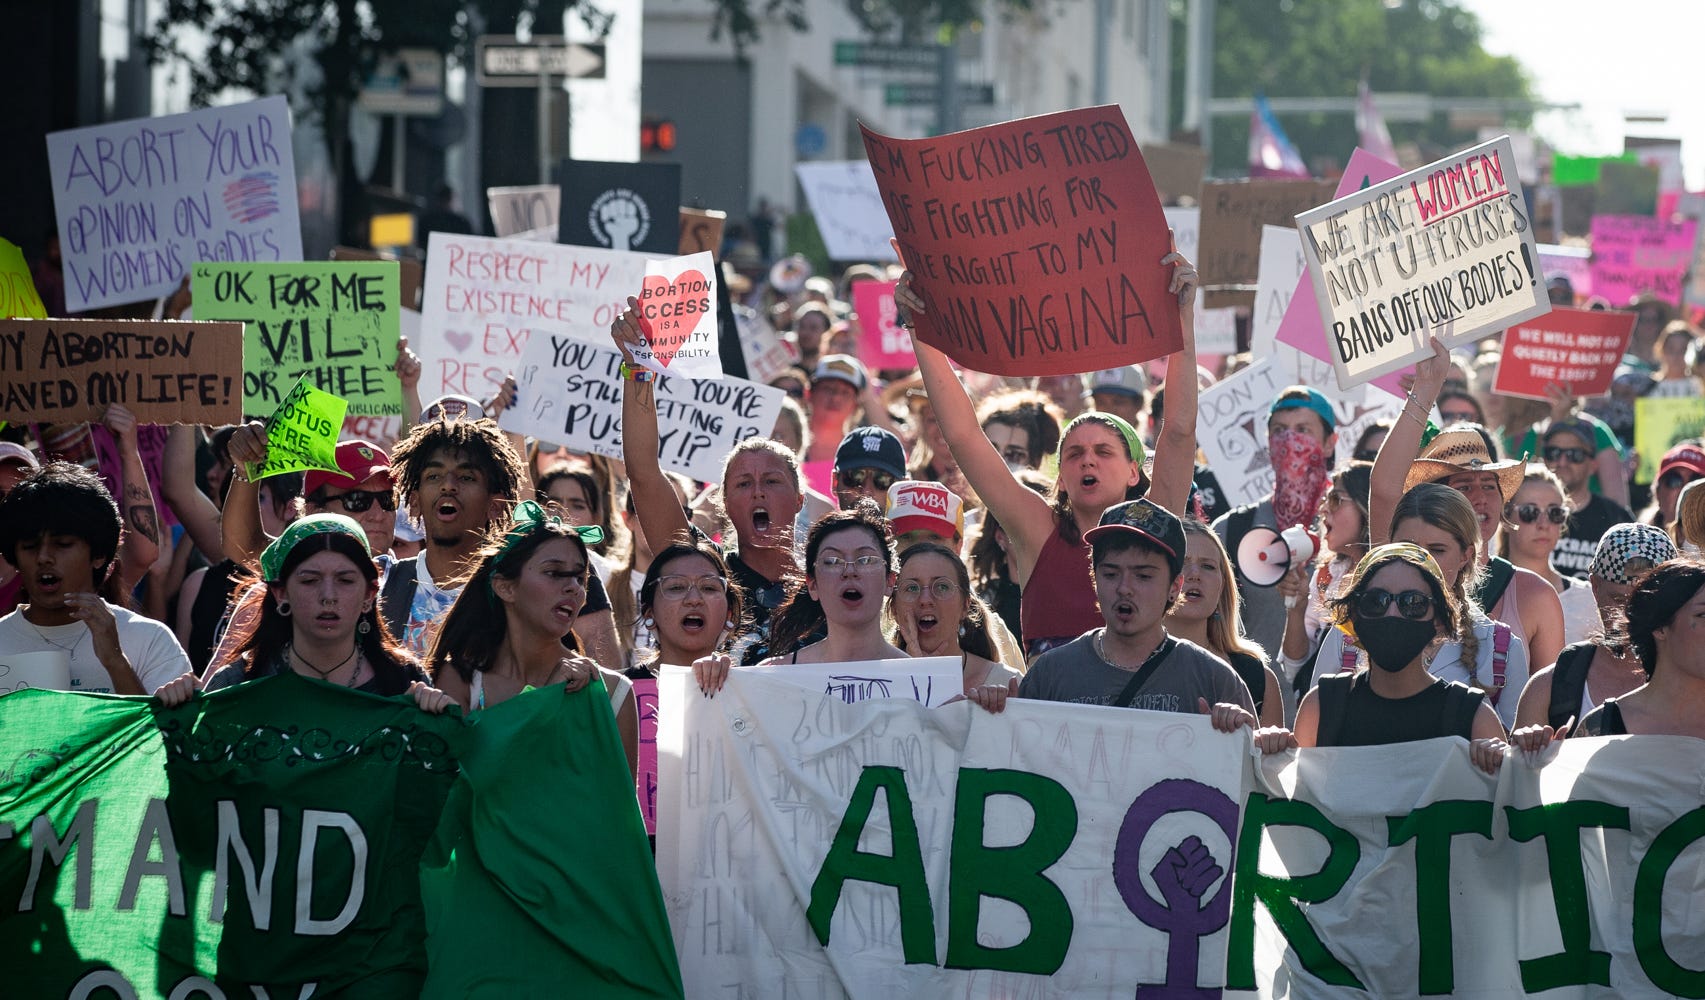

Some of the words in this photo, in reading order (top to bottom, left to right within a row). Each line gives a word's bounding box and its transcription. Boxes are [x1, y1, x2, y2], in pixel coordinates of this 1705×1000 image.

[65, 128, 185, 197] ABORT
[197, 114, 280, 182] YOUR
[867, 135, 912, 183] I'M
[918, 131, 1047, 188] FUCKING
[1044, 120, 1129, 168] TIRED
[68, 201, 157, 256] OPINION
[174, 191, 212, 240] ON
[889, 189, 917, 234] OF
[923, 185, 1058, 241] FIGHTING
[1065, 176, 1118, 219] FOR
[1304, 209, 1357, 265] WE
[1361, 185, 1416, 245] ARE
[1410, 149, 1506, 222] WOMEN
[68, 238, 184, 304] WOMEN'S
[196, 228, 280, 262] BODIES
[445, 244, 549, 285] RESPECT
[569, 260, 611, 290] MY
[942, 250, 1020, 286] RIGHT
[1028, 241, 1067, 276] TO
[1075, 220, 1117, 271] MY
[1325, 244, 1384, 308] NOT
[270, 274, 321, 310] FOR
[331, 272, 387, 312] ME
[445, 284, 574, 324] EXISTENCE
[639, 297, 710, 320] CCESS
[988, 272, 1155, 359] VAGINA
[1332, 302, 1395, 364] BANS
[1391, 287, 1424, 337] OFF
[1422, 274, 1463, 324] OUR
[1458, 242, 1538, 311] BODIES!
[39, 327, 195, 369] ABORTION
[660, 321, 670, 331] IS
[673, 319, 680, 329] A
[1518, 327, 1541, 341] WE
[1543, 330, 1575, 347] WILL
[1577, 335, 1602, 348] NOT
[551, 335, 597, 371] YOU
[691, 374, 766, 420] YOU'RE
[1513, 345, 1567, 362] QUIETLY
[1569, 351, 1601, 365] BACK
[1529, 364, 1556, 379] THE
[0, 379, 78, 412] AVED
[87, 369, 130, 406] MY
[136, 372, 232, 406] LIFE!
[566, 374, 623, 405] STILL
[1200, 366, 1278, 428] DON'T
[266, 417, 311, 451] E'RE
[912, 492, 947, 512] WBA
[0, 798, 369, 936] MAND
